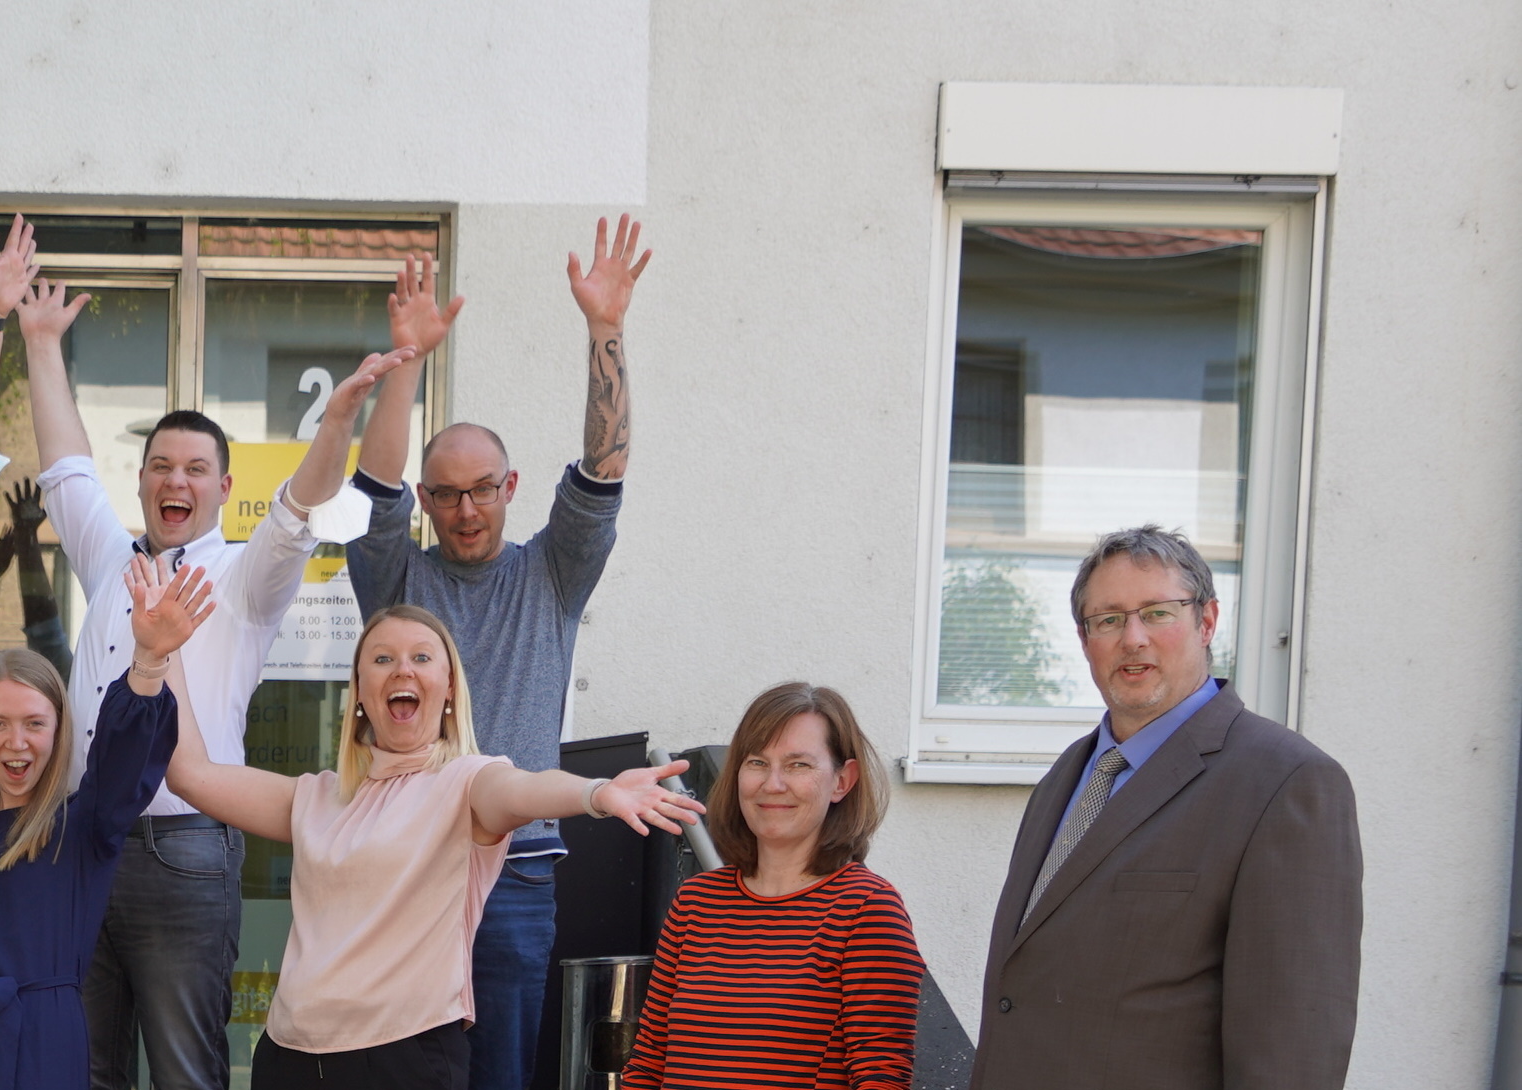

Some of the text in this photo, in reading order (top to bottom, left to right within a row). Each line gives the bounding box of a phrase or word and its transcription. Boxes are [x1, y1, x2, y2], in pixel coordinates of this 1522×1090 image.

[297, 367, 333, 440] 2
[238, 522, 247, 533] in
[299, 616, 321, 626] 8.00
[331, 616, 356, 626] 12.00
[295, 630, 321, 640] 13.00
[331, 631, 357, 641] 15.30
[249, 701, 288, 723] ach
